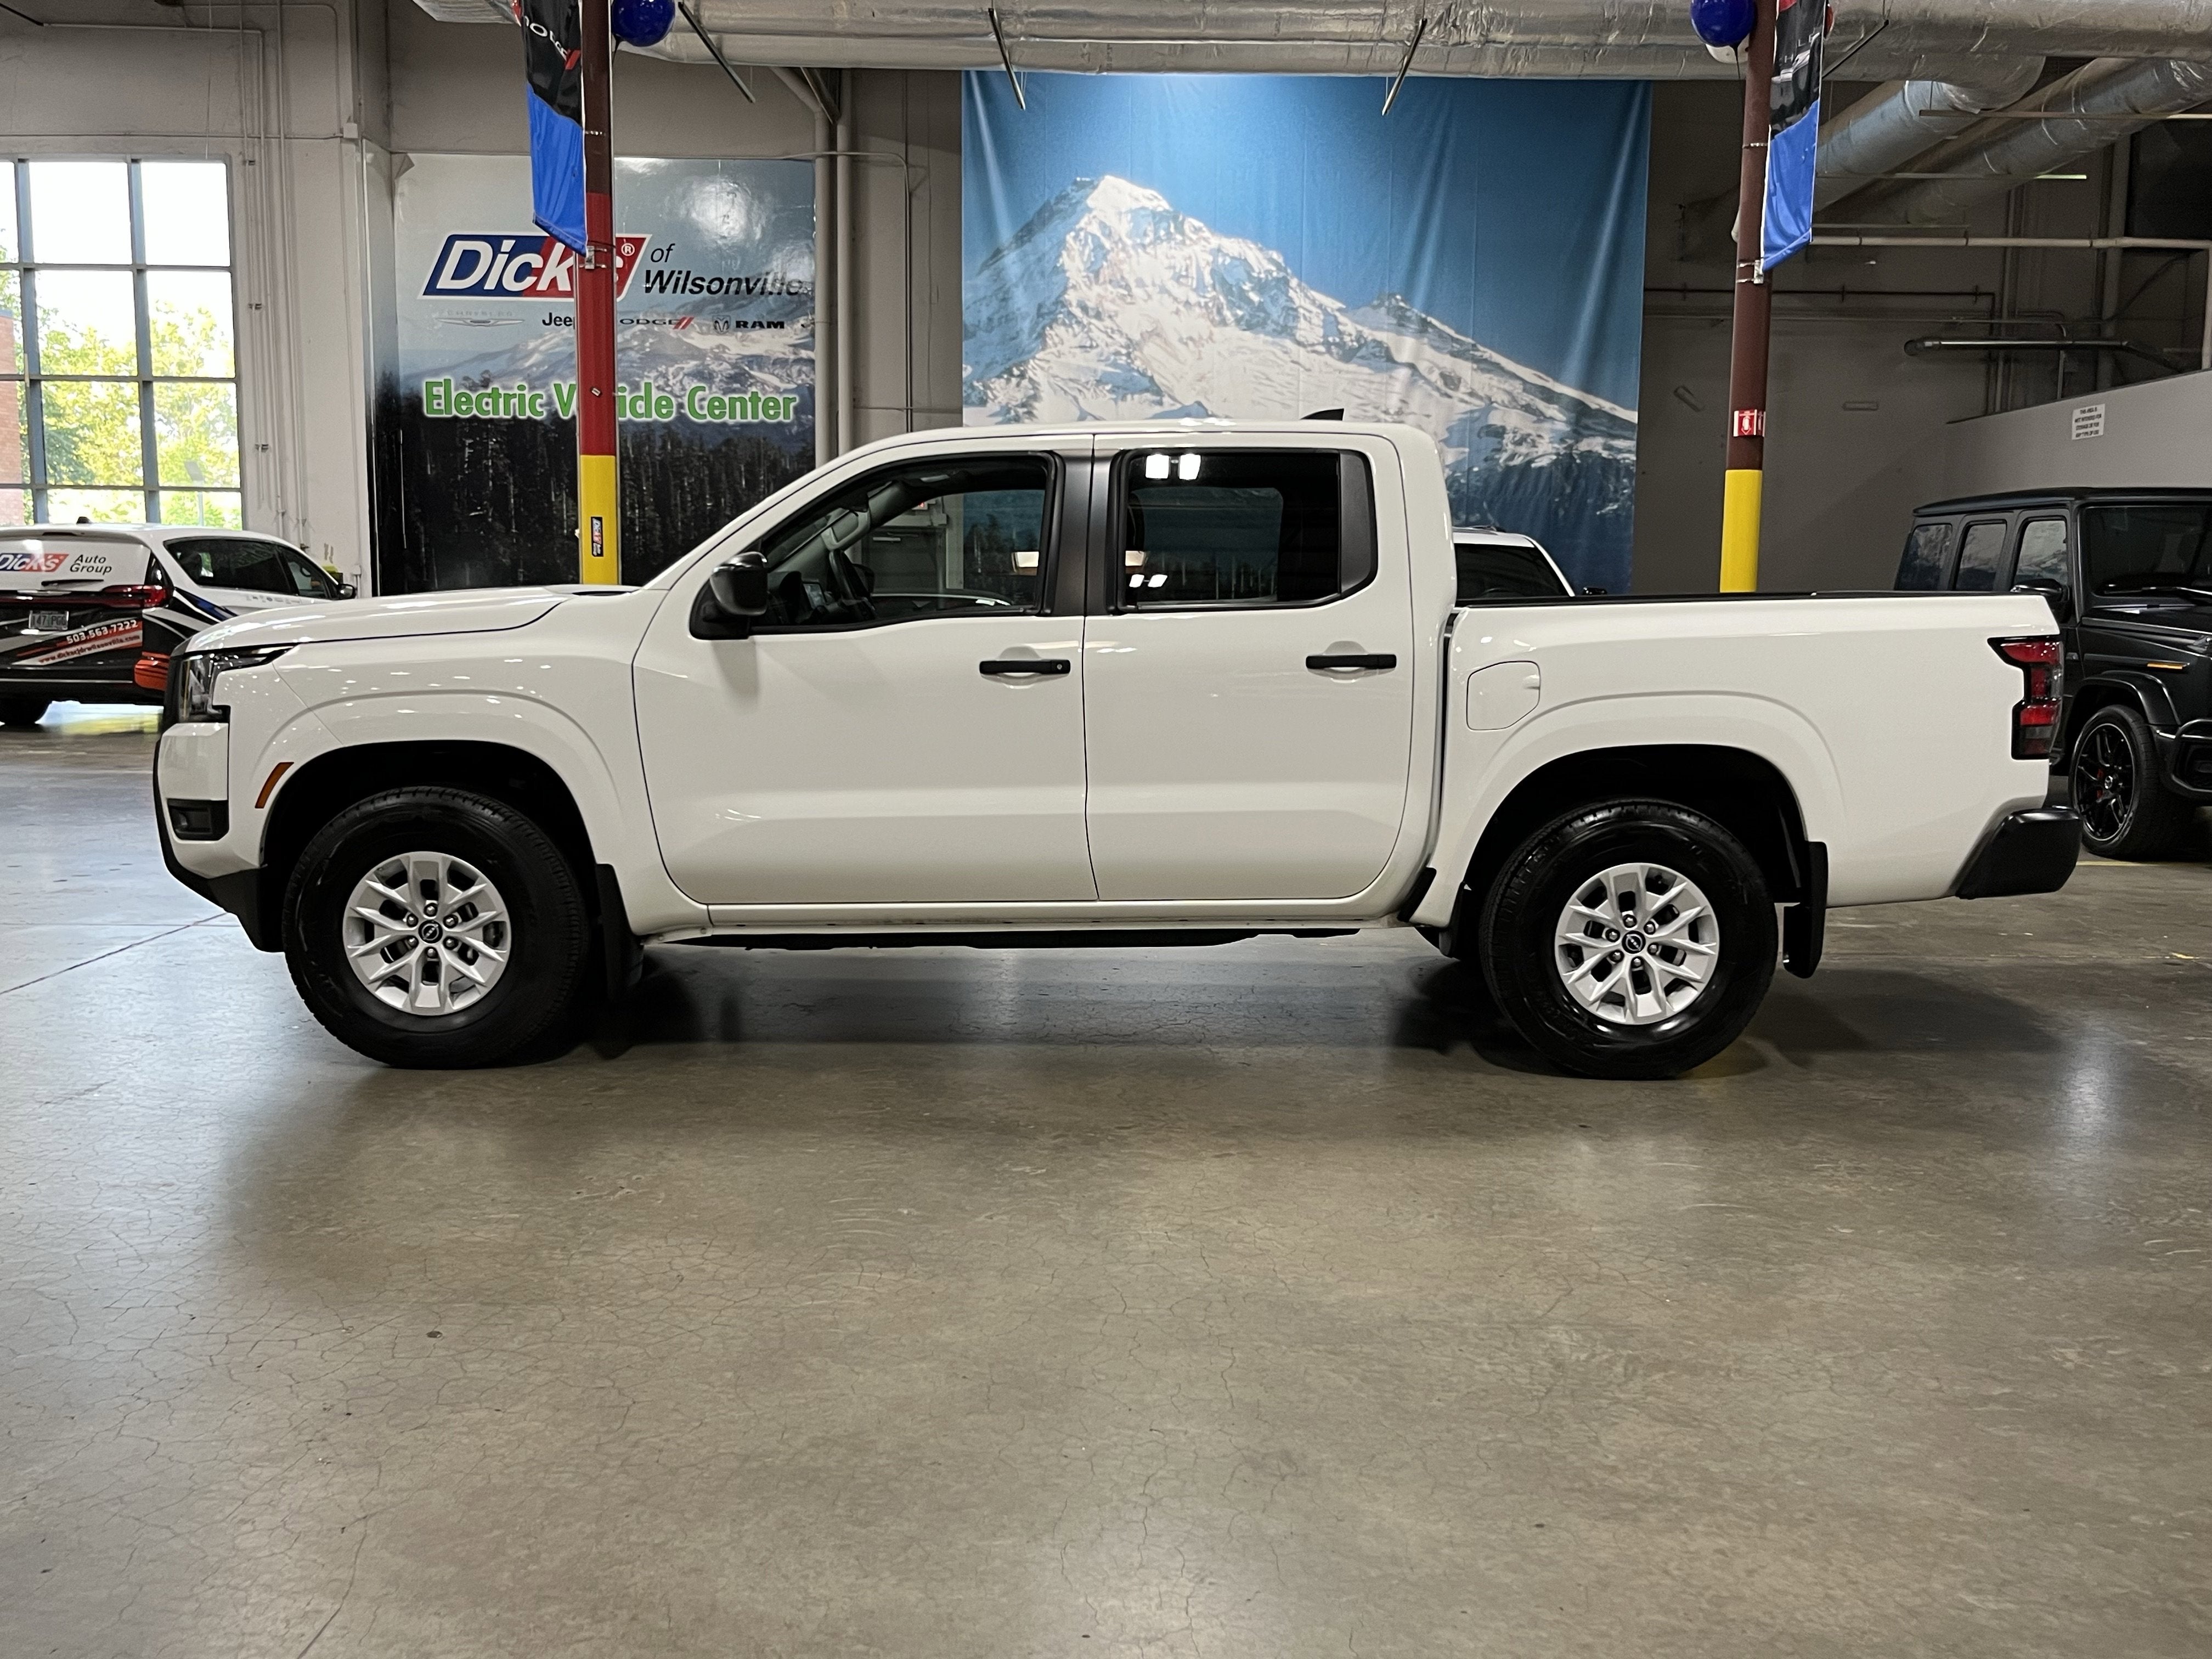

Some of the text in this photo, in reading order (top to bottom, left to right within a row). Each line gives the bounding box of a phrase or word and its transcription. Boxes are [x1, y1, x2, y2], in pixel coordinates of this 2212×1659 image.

[651, 243, 675, 263] of
[436, 240, 623, 291] Dick
[542, 312, 575, 329] Jee
[736, 320, 785, 329] RAM
[425, 378, 797, 420] Electric Vicle Center
[75, 554, 107, 564] Auto
[70, 563, 112, 575] Group
